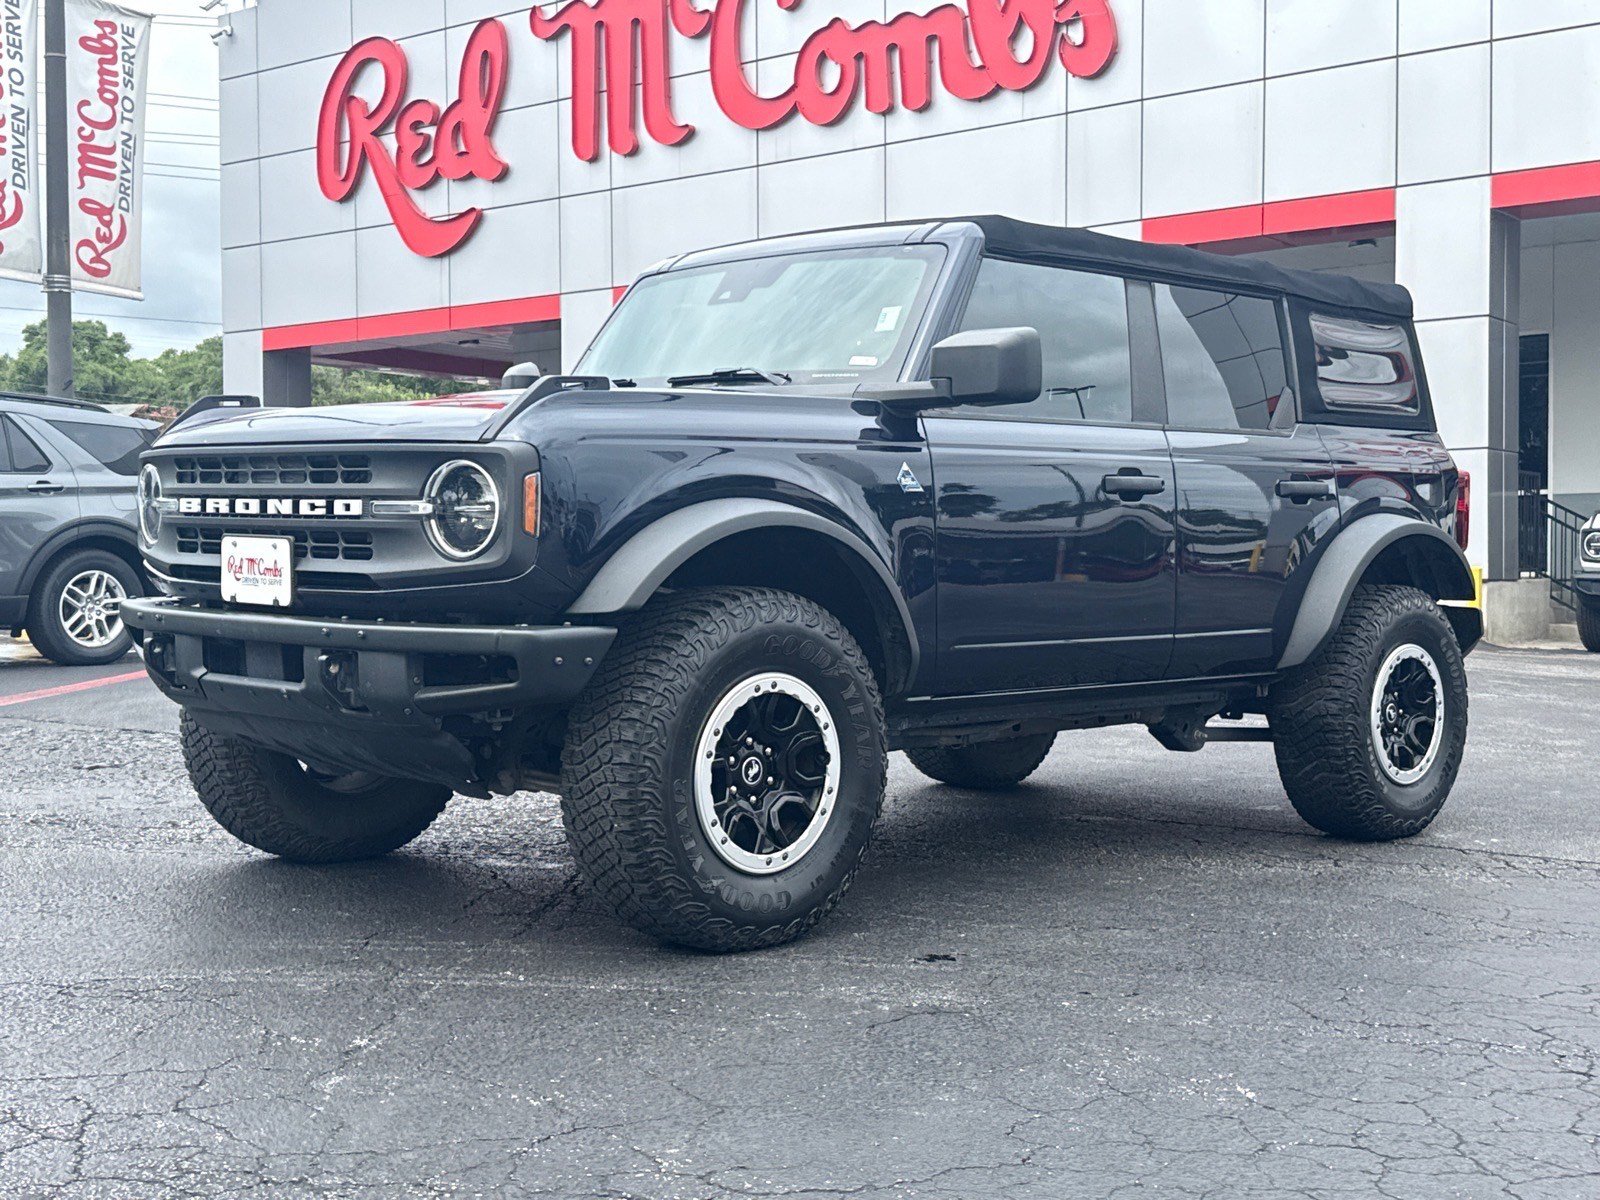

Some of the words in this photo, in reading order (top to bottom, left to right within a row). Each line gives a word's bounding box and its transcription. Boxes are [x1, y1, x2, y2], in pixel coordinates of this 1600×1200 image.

[7, 68, 26, 99] TO
[120, 23, 136, 92] SERVE
[76, 18, 120, 190] McCombs
[120, 95, 135, 125] TO
[315, 17, 510, 259] Red
[10, 103, 27, 191] DRIVEN
[118, 131, 134, 214] DRIVEN
[75, 197, 128, 278] Red
[178, 497, 363, 516] BRONCO
[228, 555, 243, 581] Red
[244, 557, 284, 578] McCombs
[242, 577, 260, 585] DRIVEN
[268, 578, 283, 587] SERVE
